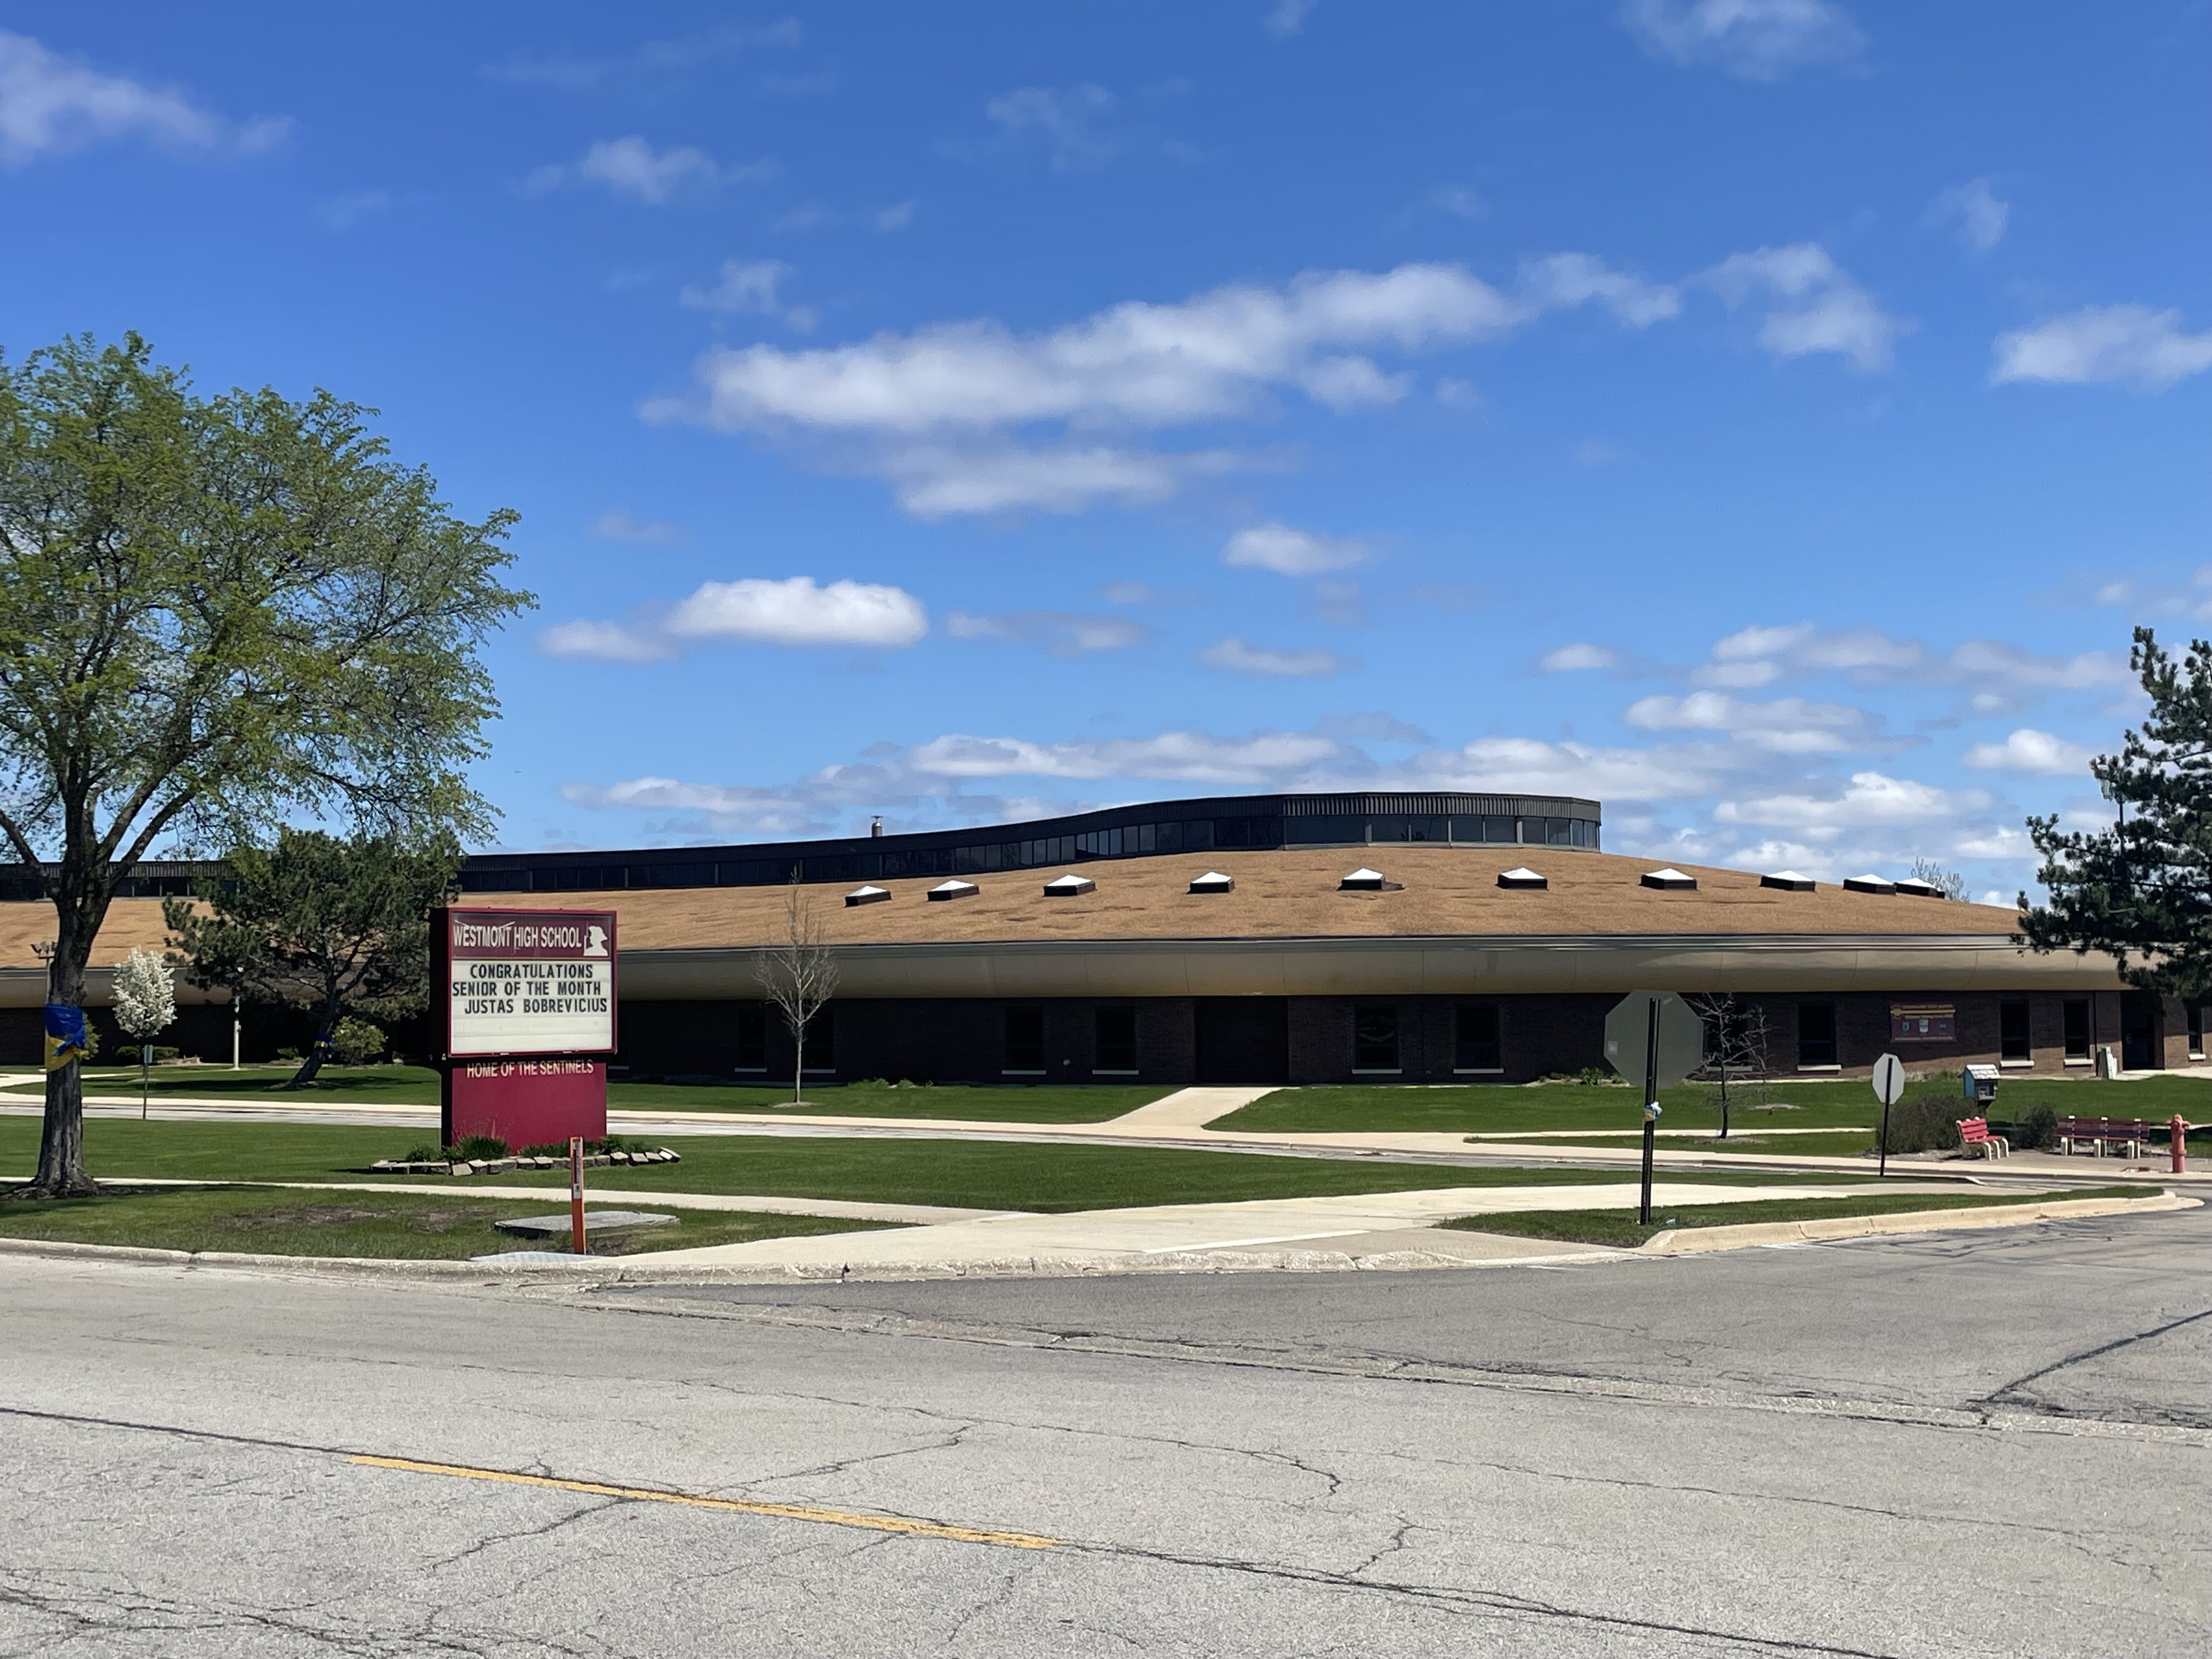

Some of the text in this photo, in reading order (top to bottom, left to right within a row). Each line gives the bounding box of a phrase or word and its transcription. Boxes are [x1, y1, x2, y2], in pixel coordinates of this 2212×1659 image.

[453, 926, 582, 947] WESTMONT HIGH SCHOOL
[470, 964, 593, 979] CONGRATULATIONS
[452, 981, 601, 996] SENIOR OF THE MONTH
[465, 998, 607, 1014] JUSTAS BOBREVICIUS
[467, 1059, 594, 1078] HOME OF THE SENTINELS
